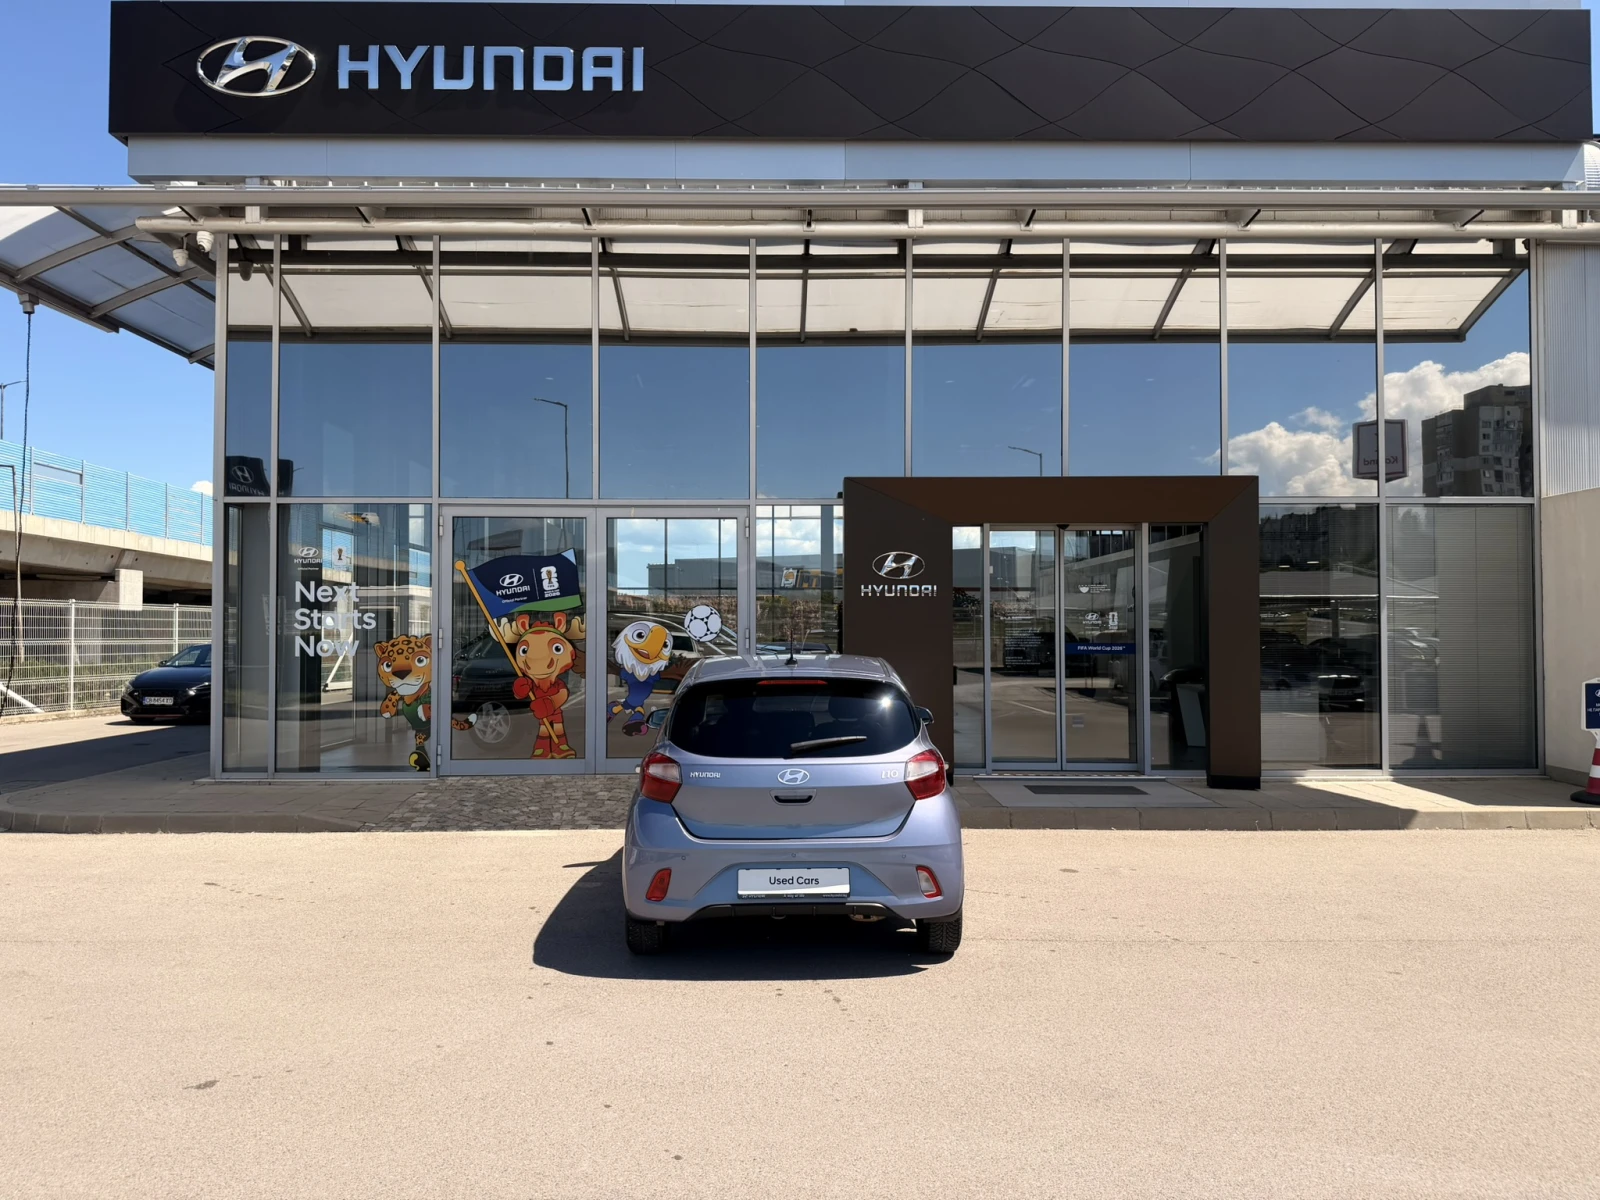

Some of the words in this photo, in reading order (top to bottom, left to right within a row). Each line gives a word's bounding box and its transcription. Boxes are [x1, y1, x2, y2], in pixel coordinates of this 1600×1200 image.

[338, 45, 644, 91] HYUNDAI
[294, 580, 360, 602] Next
[496, 585, 531, 596] HYUNDAI
[861, 584, 937, 596] HYUNDAI
[294, 608, 376, 630] Starts
[294, 636, 360, 658] Now
[769, 875, 794, 885] Used
[796, 876, 820, 885] Cars
